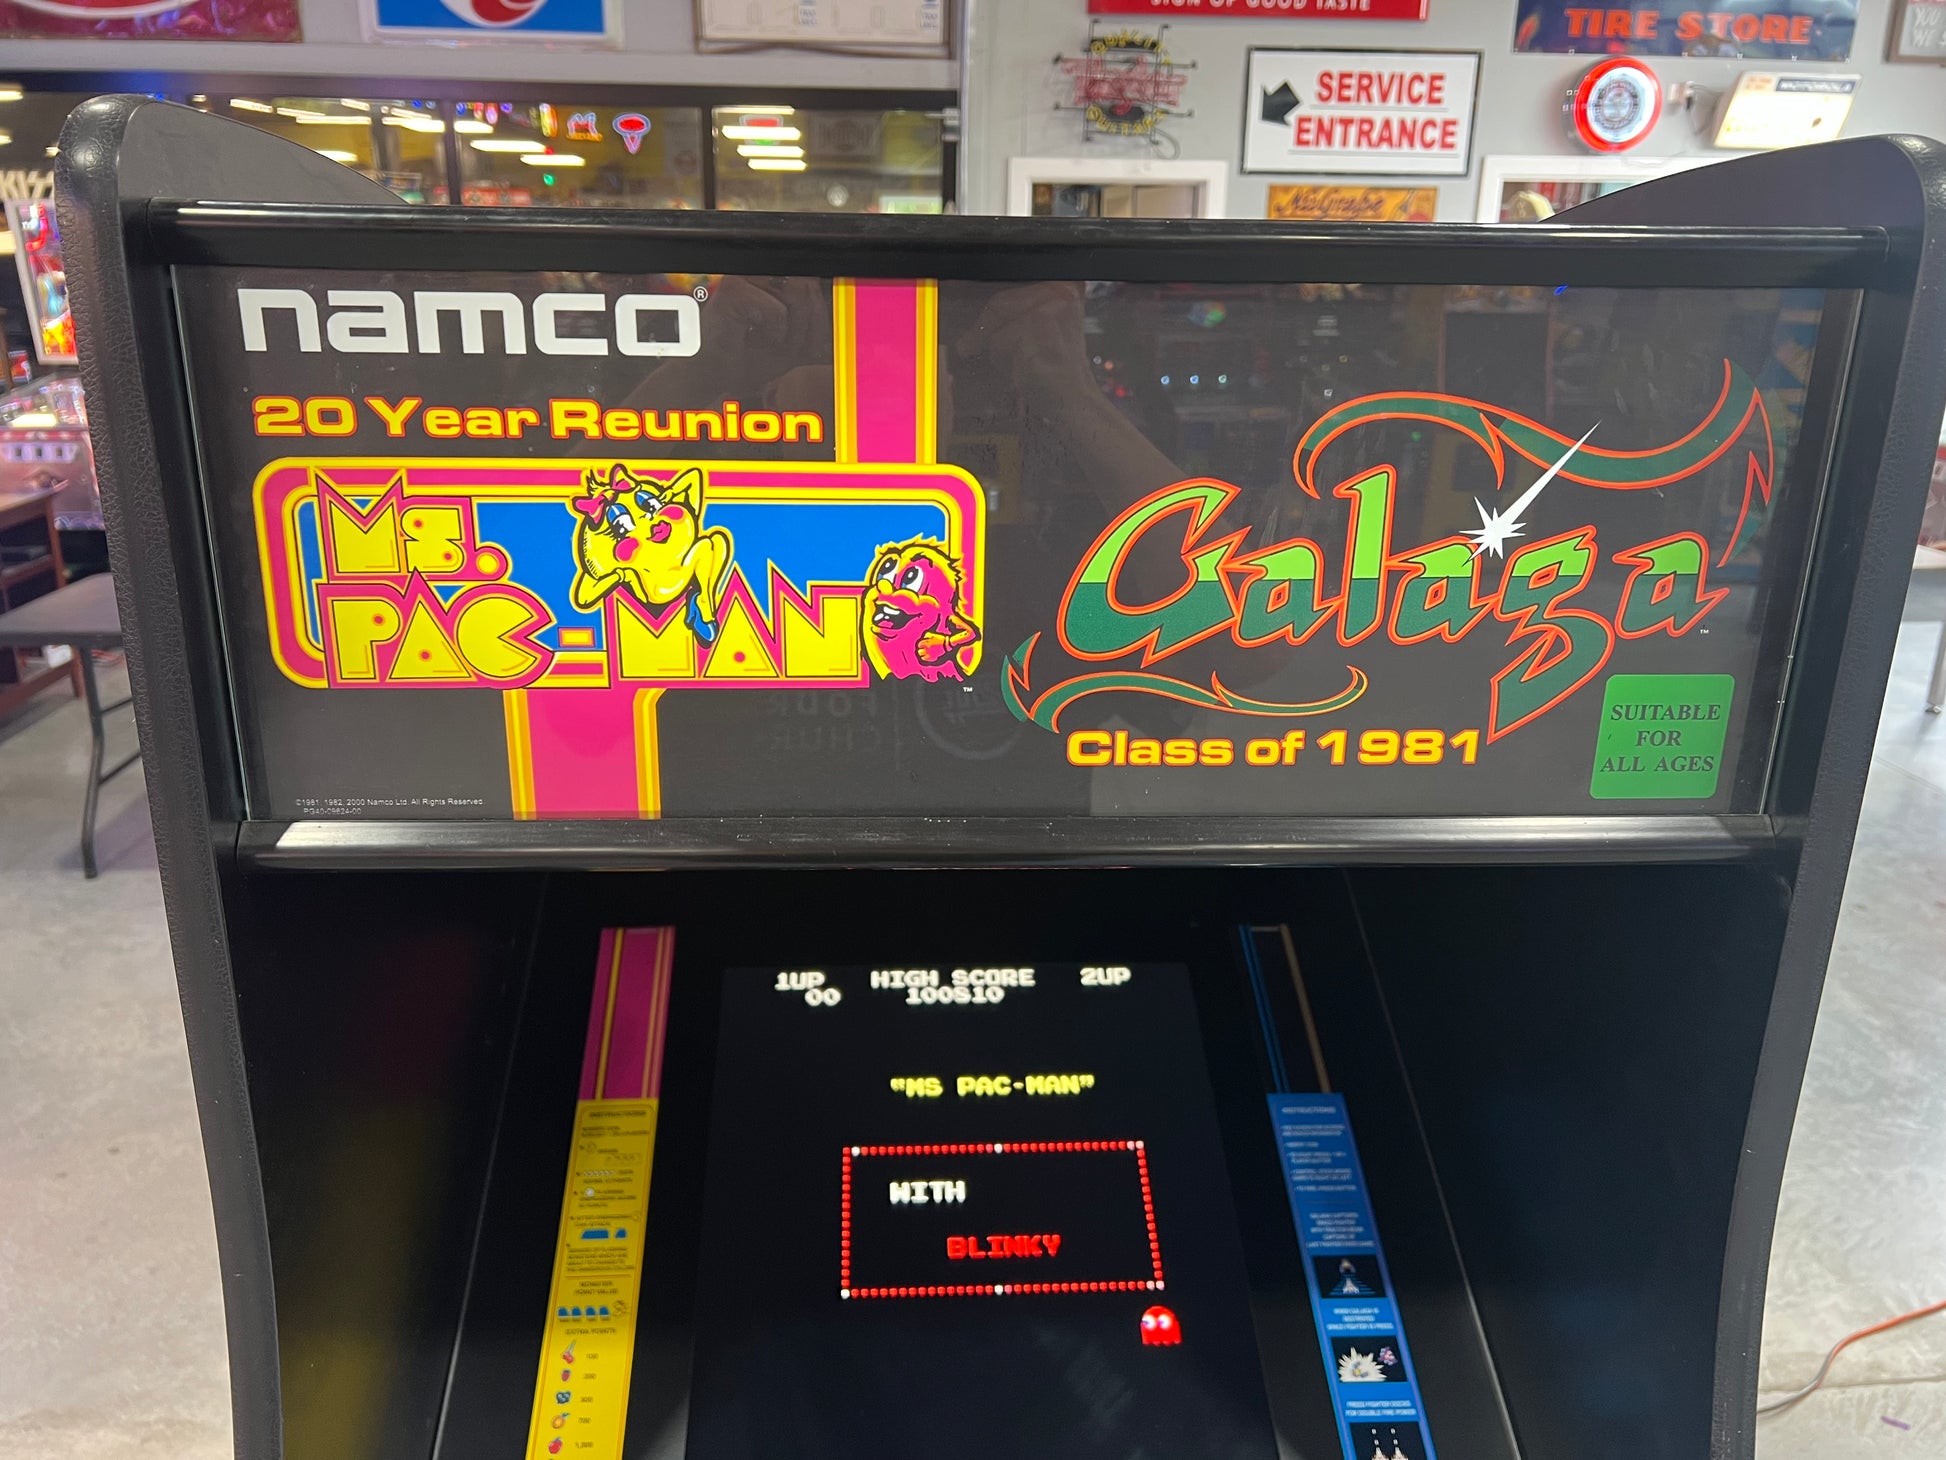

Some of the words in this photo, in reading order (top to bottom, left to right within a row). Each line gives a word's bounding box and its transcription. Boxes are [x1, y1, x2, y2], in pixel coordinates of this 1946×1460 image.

[1566, 8, 1659, 38] TIRE
[1676, 11, 1812, 44] STORE
[1316, 69, 1446, 104] SERVICE
[1295, 115, 1459, 149] ENTRANCE
[252, 395, 357, 437] 20
[363, 397, 540, 439] Year
[548, 398, 824, 443] Reunion
[1057, 462, 1732, 743] Galaga
[326, 563, 869, 688] PAC-MAN
[1611, 704, 1721, 721] SUITABLE
[1066, 729, 1234, 767] Class
[1244, 729, 1306, 767] of
[1316, 728, 1481, 766] 1981
[1636, 730, 1682, 747] FOR
[1600, 756, 1645, 772] ALL
[1654, 756, 1715, 772] AGES
[346, 798, 365, 806] 2000
[367, 798, 394, 806] Namco
[422, 797, 446, 807] Rights
[774, 971, 825, 991] 1UP
[870, 969, 939, 988] HIGH
[951, 968, 1036, 987] SCORE
[1079, 966, 1131, 986] 2UP
[804, 988, 841, 1006] 00
[889, 1180, 966, 1204] WITH
[946, 1234, 1061, 1259] BLINKY
